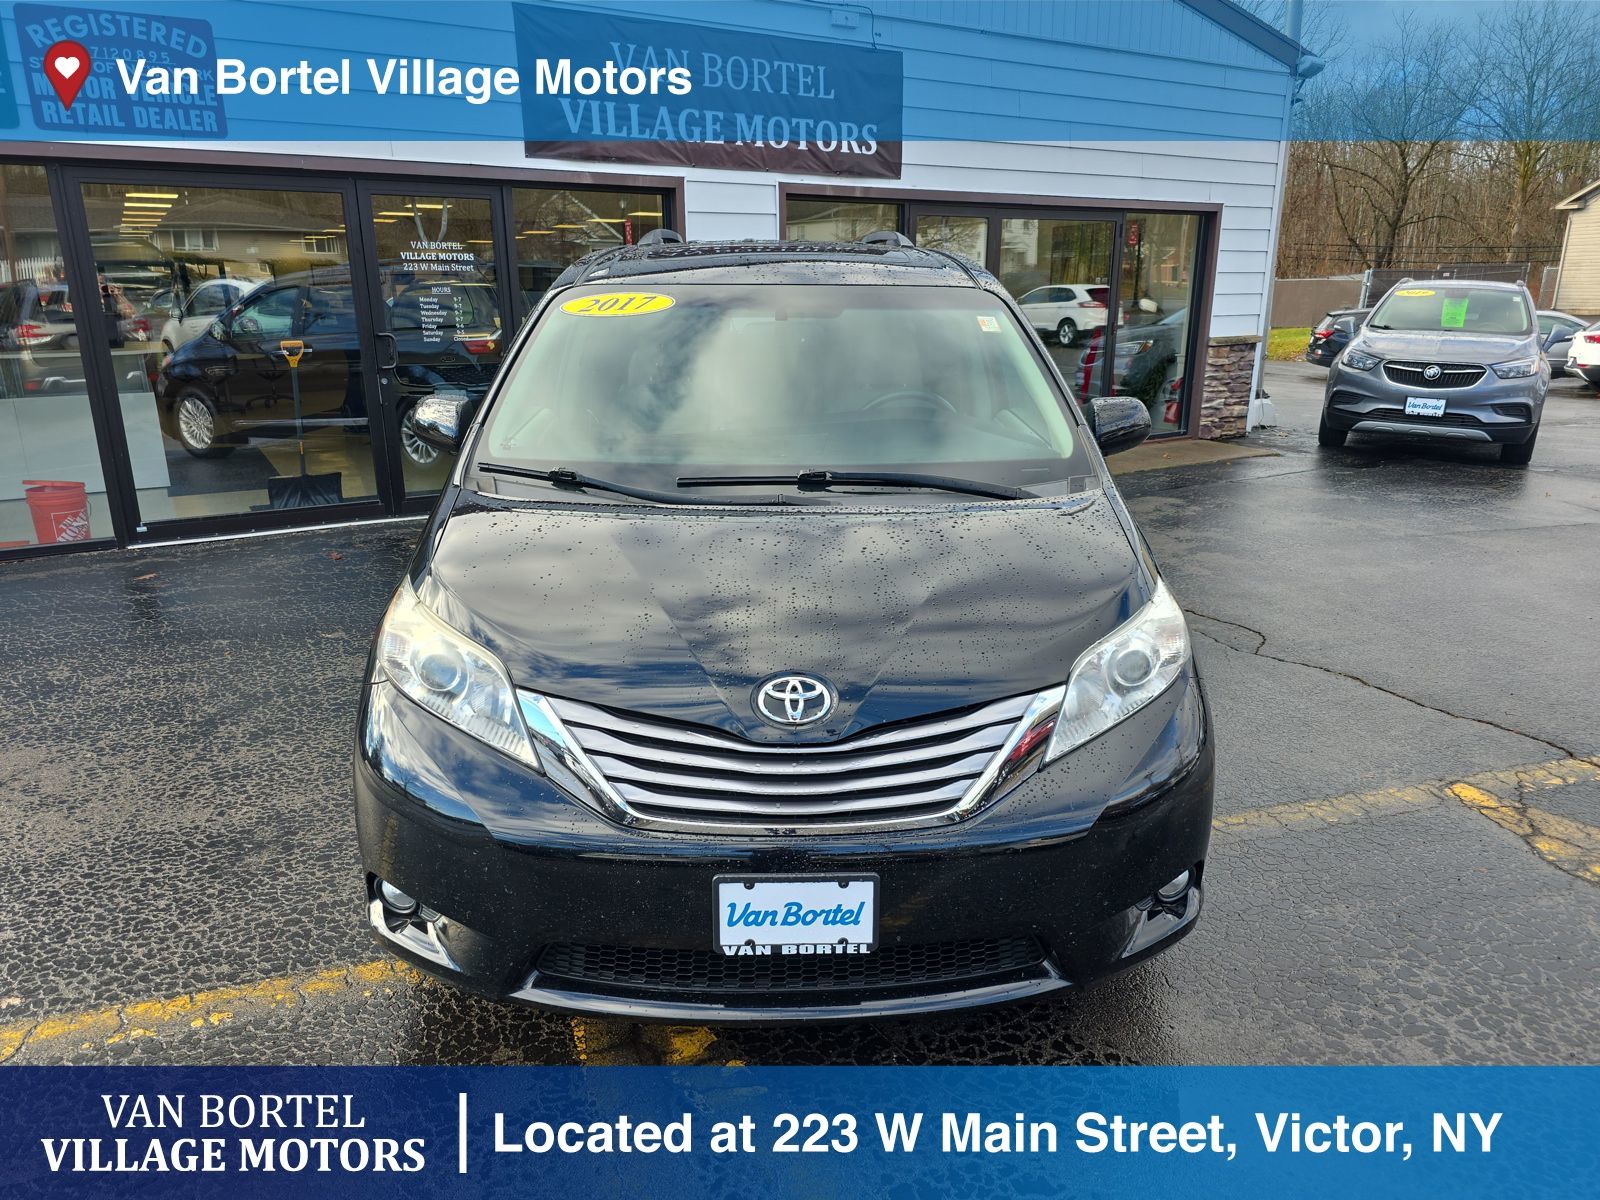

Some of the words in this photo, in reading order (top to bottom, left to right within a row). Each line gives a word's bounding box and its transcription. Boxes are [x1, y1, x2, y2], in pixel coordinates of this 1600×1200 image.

[25, 13, 208, 59] REGISTERED
[93, 61, 117, 74] OF
[702, 52, 835, 100] BORTEL
[32, 72, 117, 100] MOR
[41, 101, 126, 128] RETAIL
[132, 106, 218, 132] DEALER
[558, 97, 725, 145] VILLAGE
[735, 112, 877, 156] MOTORS
[400, 251, 436, 260] VILLAGE
[438, 252, 475, 261] MOTORS
[410, 240, 428, 249] VAN
[430, 241, 463, 250] BORTEL
[403, 263, 418, 271] 223
[419, 263, 429, 271] W
[430, 263, 450, 272] Main
[451, 263, 474, 272] Street
[577, 295, 657, 312] 2017
[727, 902, 779, 928] Van
[780, 901, 866, 927] Bortel
[722, 945, 772, 956] VAN
[781, 943, 871, 955] BORTEL
